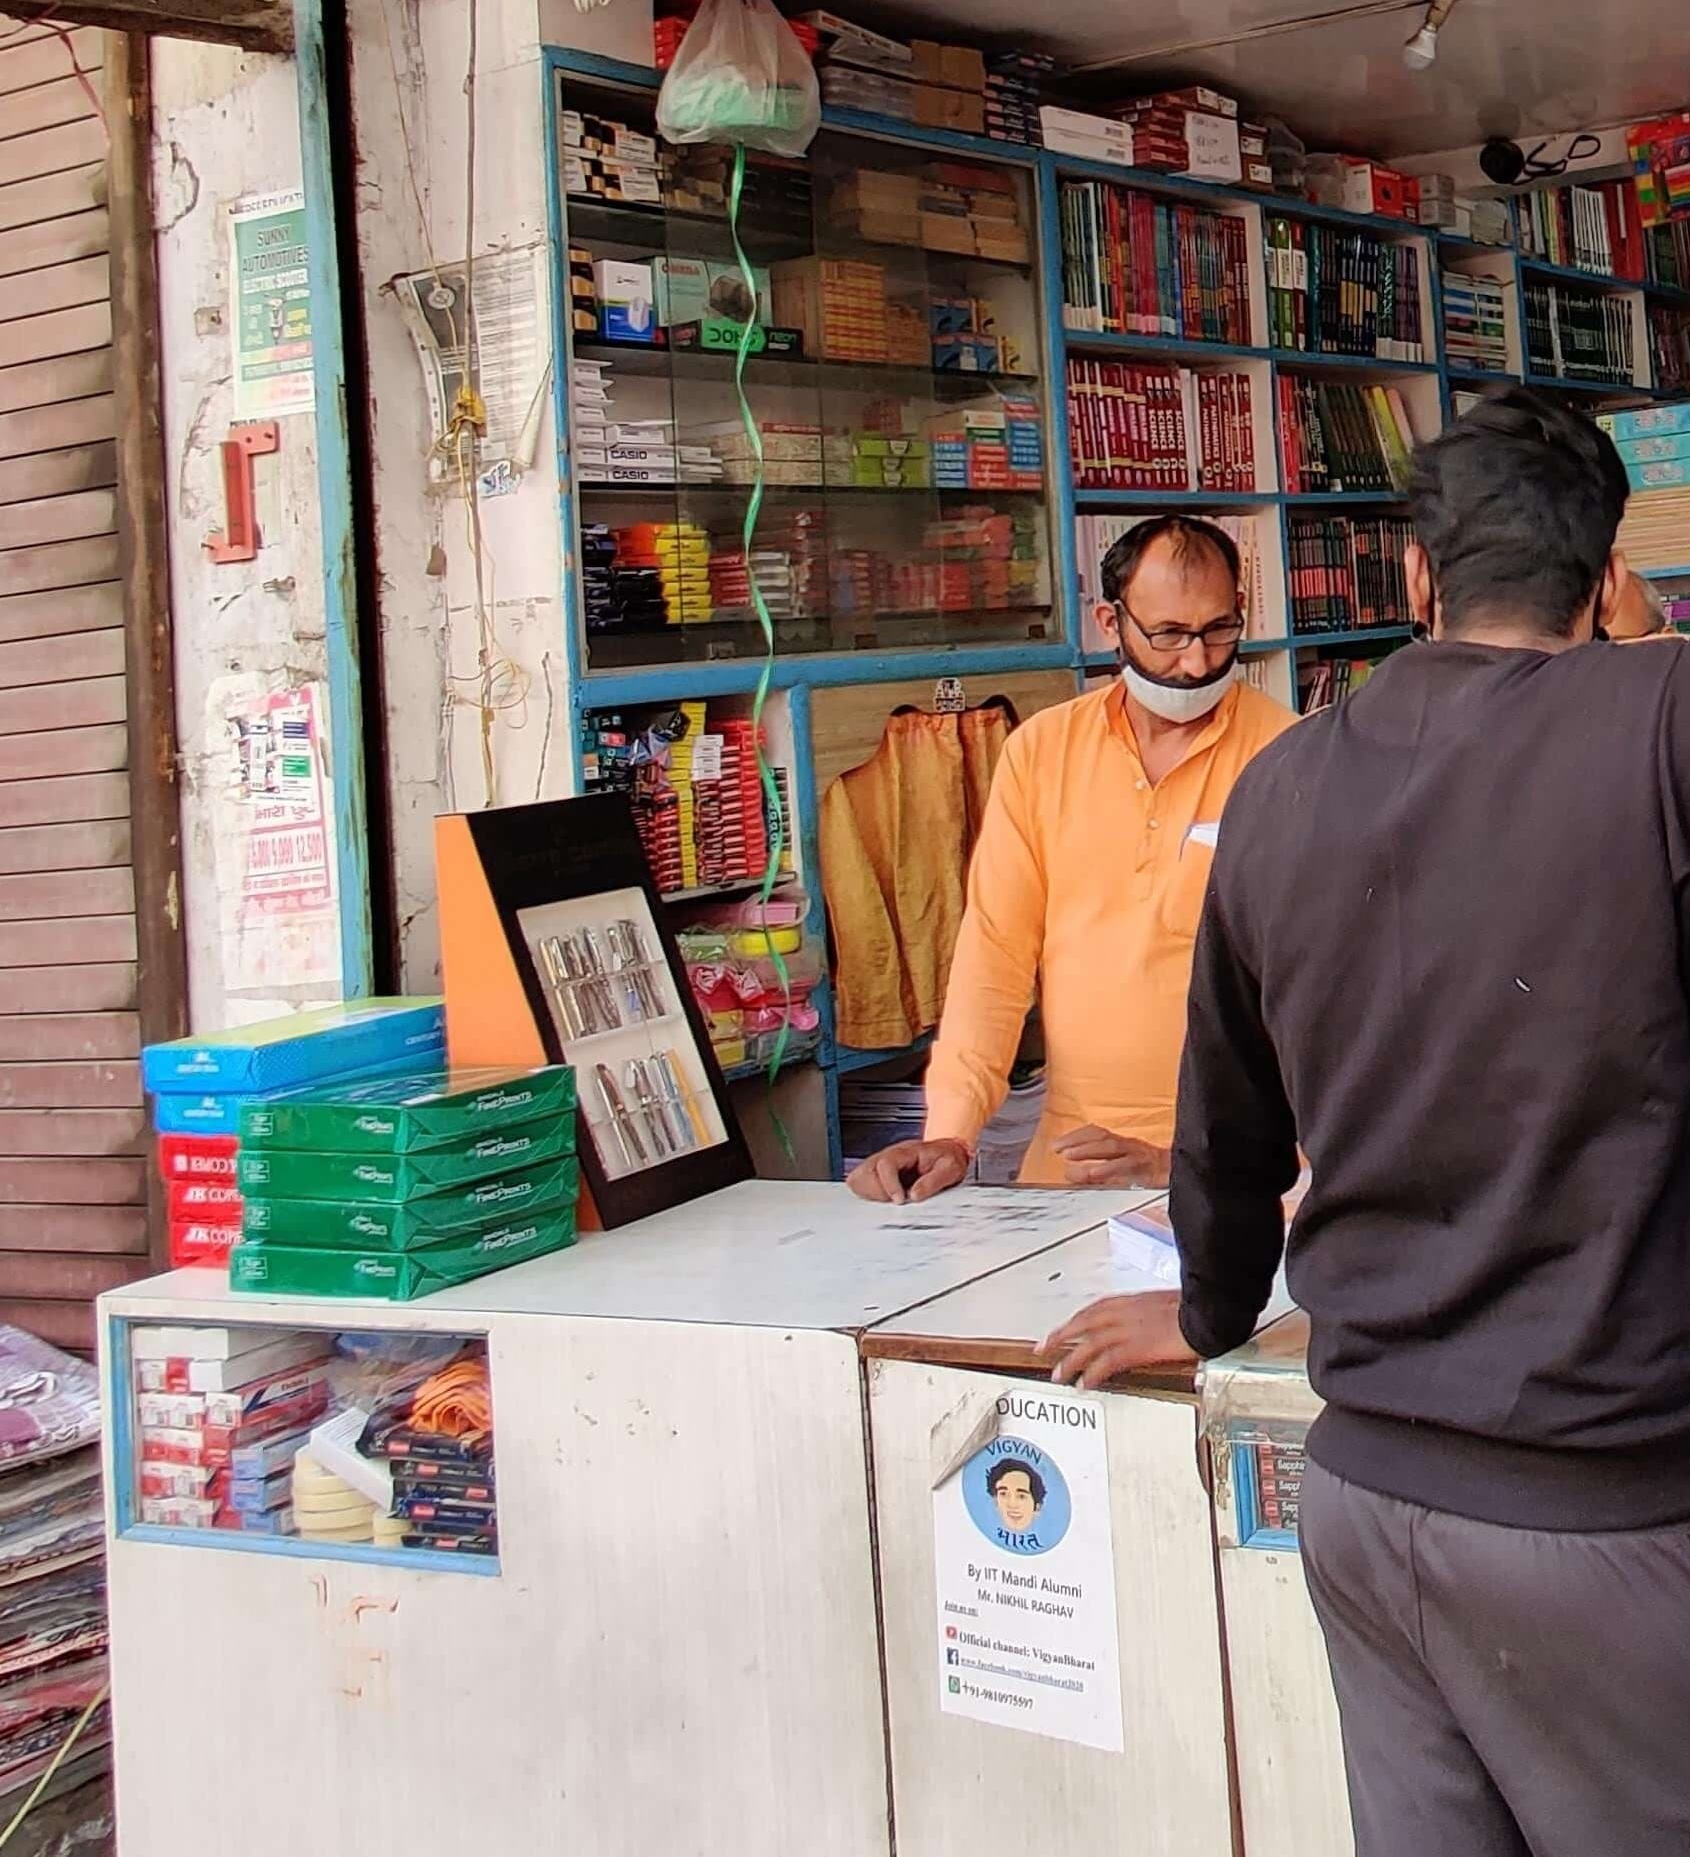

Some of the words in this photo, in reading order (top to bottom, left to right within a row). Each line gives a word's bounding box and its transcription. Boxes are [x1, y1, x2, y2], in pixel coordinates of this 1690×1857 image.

[610, 449, 648, 460] CASIO
[612, 470, 649, 480] CASIO
[985, 1439, 1042, 1465] VIGYAN
[996, 1526, 1044, 1551] भारत
[968, 1564, 982, 1581] By
[984, 1568, 998, 1581] IIT
[1001, 1570, 1037, 1590] Mandi
[1041, 1578, 1083, 1599] Alumni
[977, 1589, 993, 1603] Mr.
[996, 1593, 1029, 1610] NIKHIL
[1031, 1600, 1074, 1619] RAGHAV
[959, 1631, 991, 1649] Official
[1032, 1647, 1096, 1671] VigyanBharat
